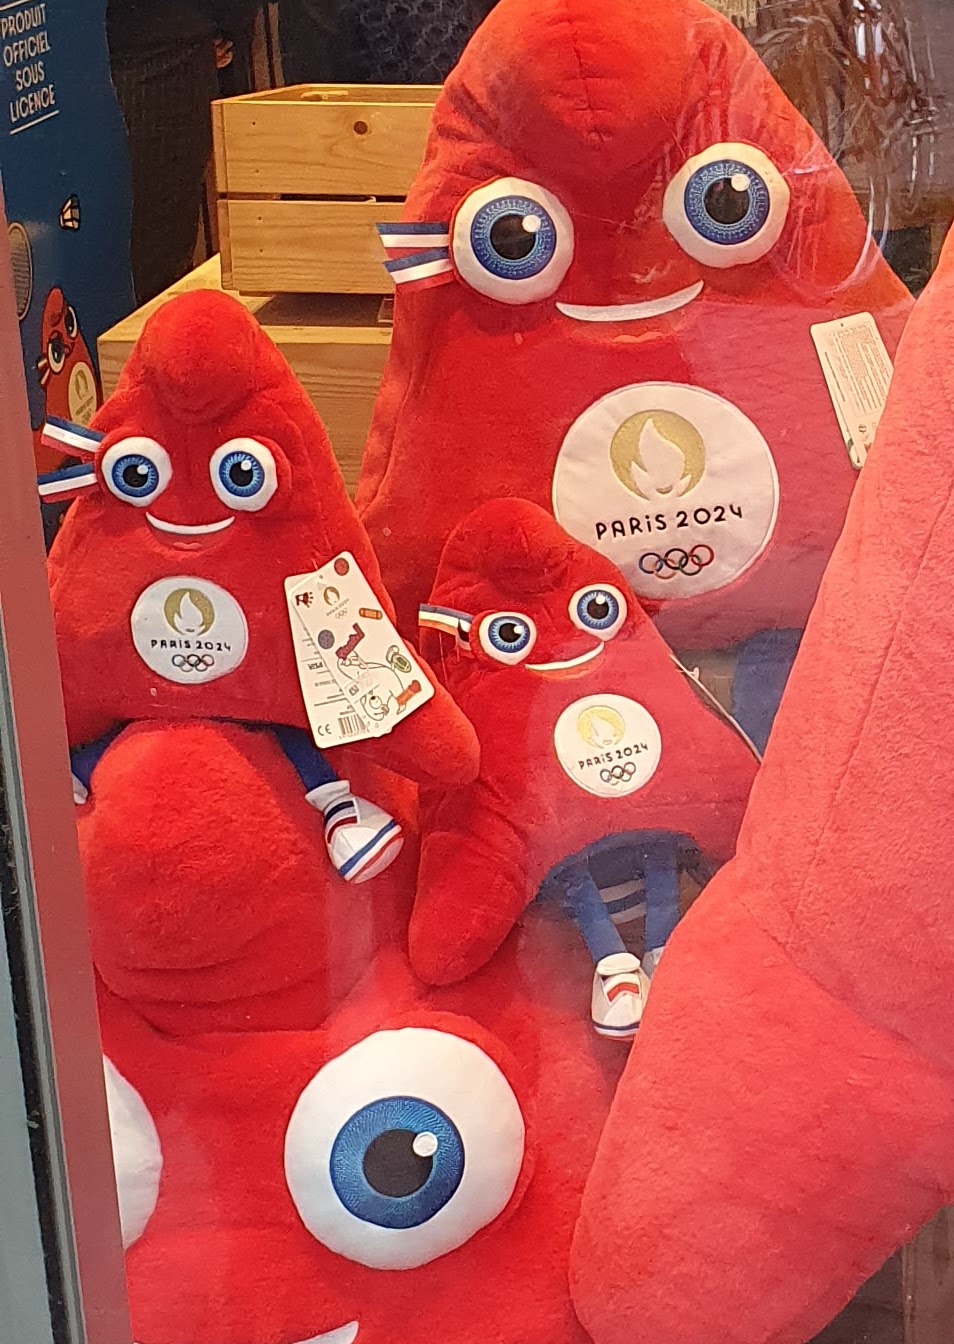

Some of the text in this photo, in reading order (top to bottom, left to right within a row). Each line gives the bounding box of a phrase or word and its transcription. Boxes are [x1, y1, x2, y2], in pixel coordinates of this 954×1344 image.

[1, 4, 46, 40] PRODUIT
[3, 31, 51, 67] OFFICIEL
[15, 60, 45, 92] SOUS
[9, 84, 56, 123] LICENCE
[675, 504, 743, 529] 2024
[195, 640, 231, 652] 2024
[615, 742, 649, 760] 2024
